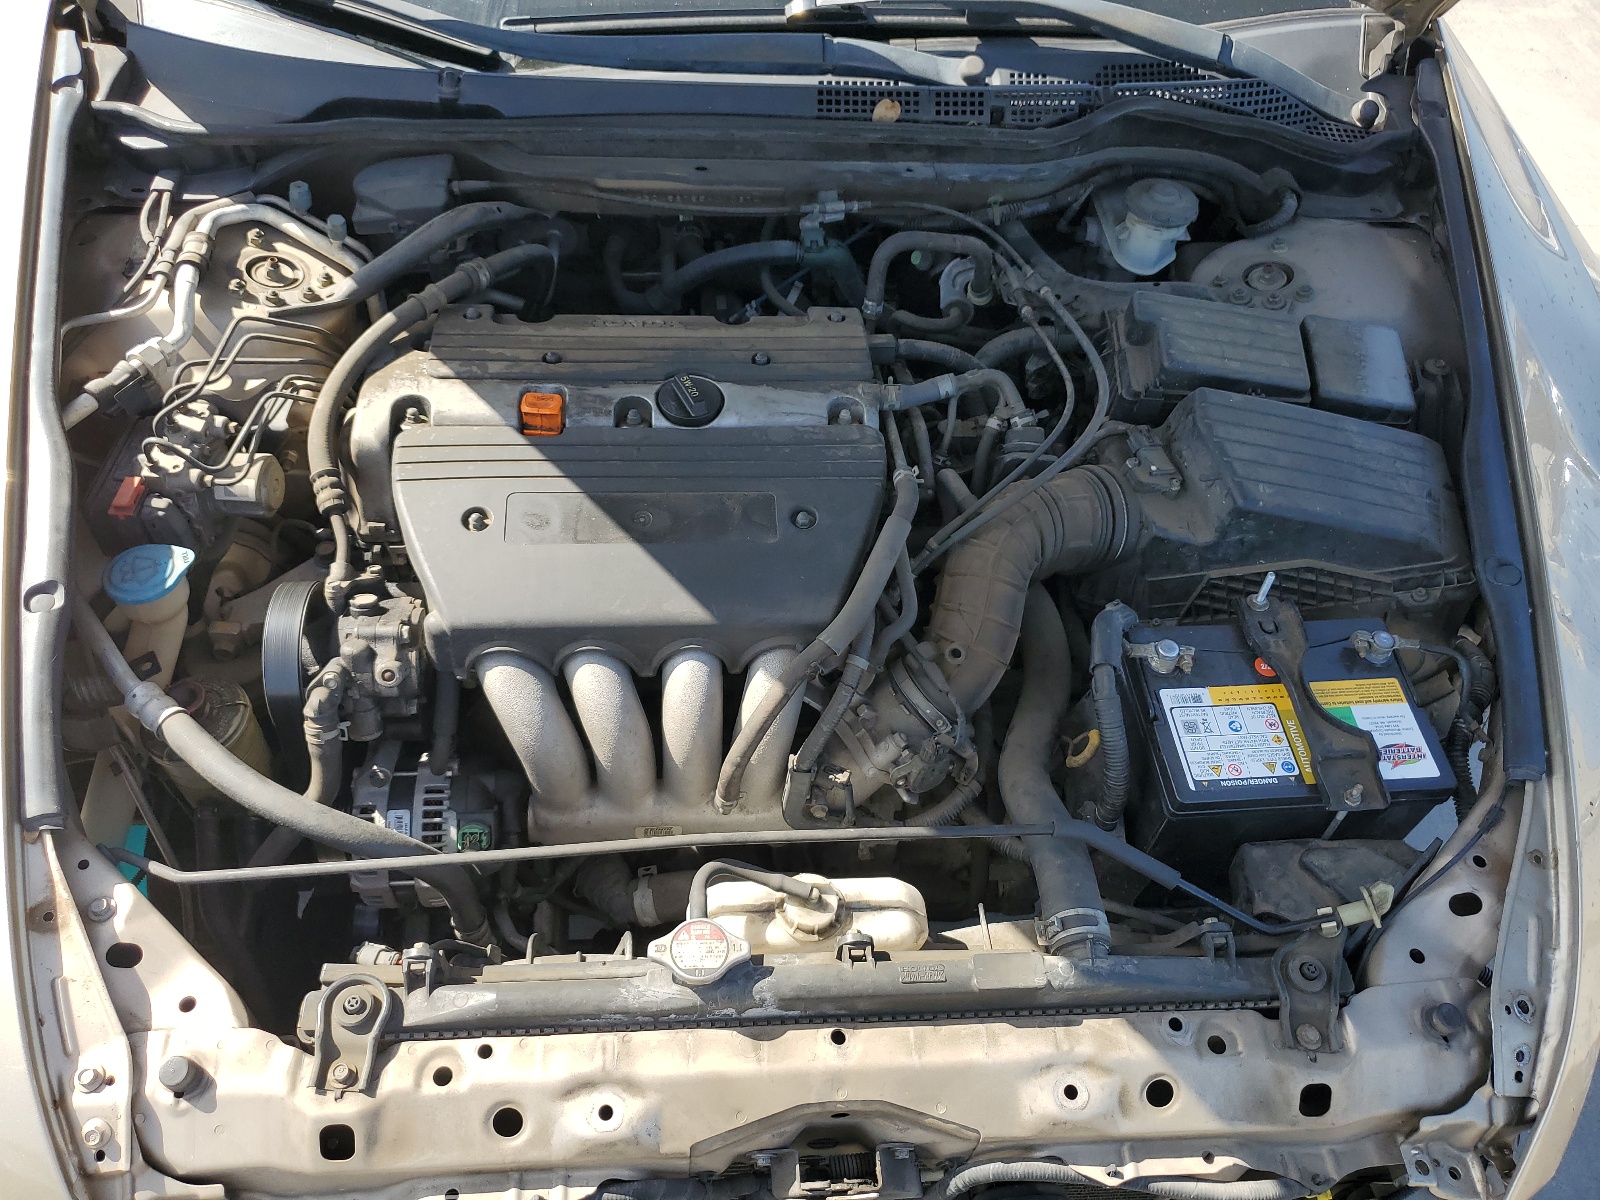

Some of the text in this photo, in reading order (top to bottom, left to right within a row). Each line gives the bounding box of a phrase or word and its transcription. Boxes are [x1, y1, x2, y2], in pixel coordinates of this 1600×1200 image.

[1286, 719, 1312, 773] AUTOMOTIVE
[1379, 753, 1426, 761] INTERSTAT
[1220, 777, 1278, 787] DANGER/POISON
